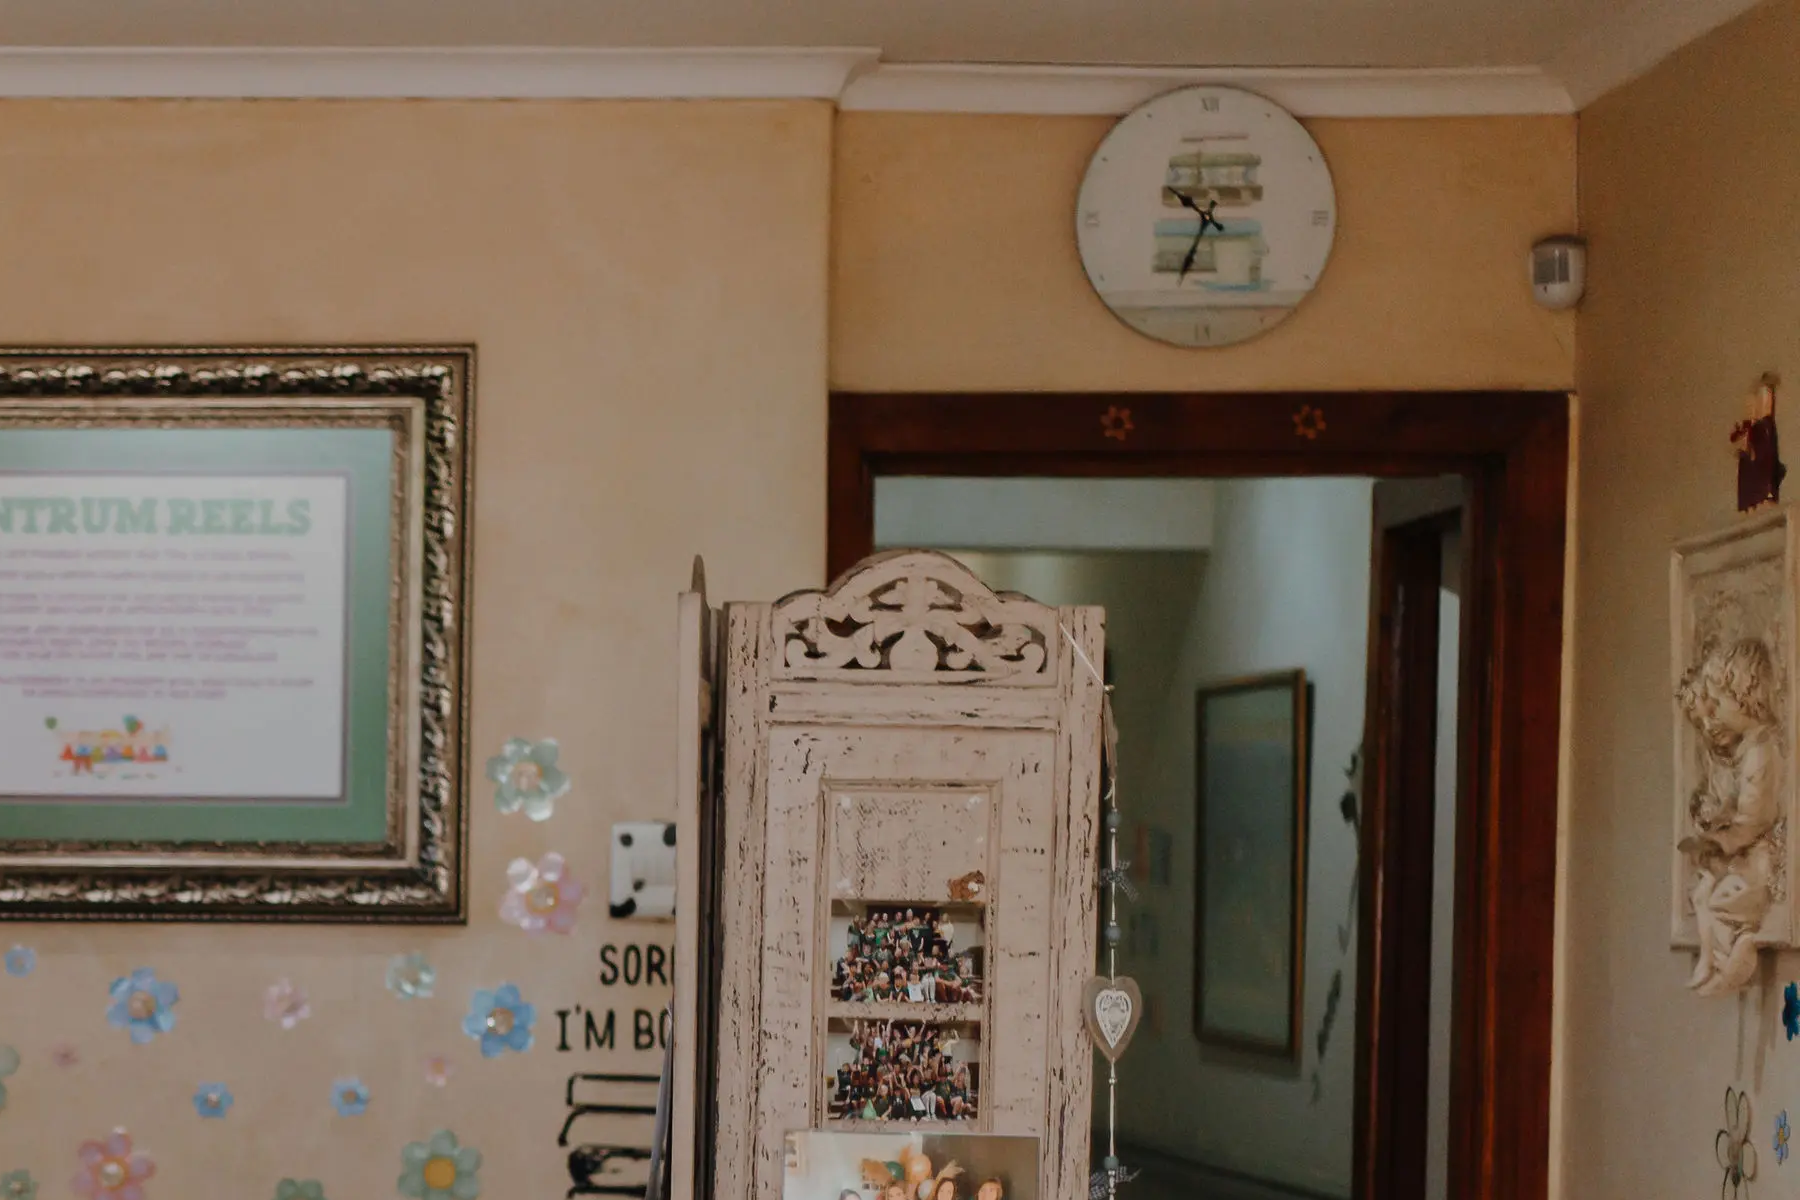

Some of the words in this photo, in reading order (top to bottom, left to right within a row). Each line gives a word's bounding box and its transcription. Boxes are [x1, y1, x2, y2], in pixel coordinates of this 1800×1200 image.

[167, 497, 312, 536] REELS
[600, 943, 675, 986] SOR
[554, 1003, 615, 1051] I'M
